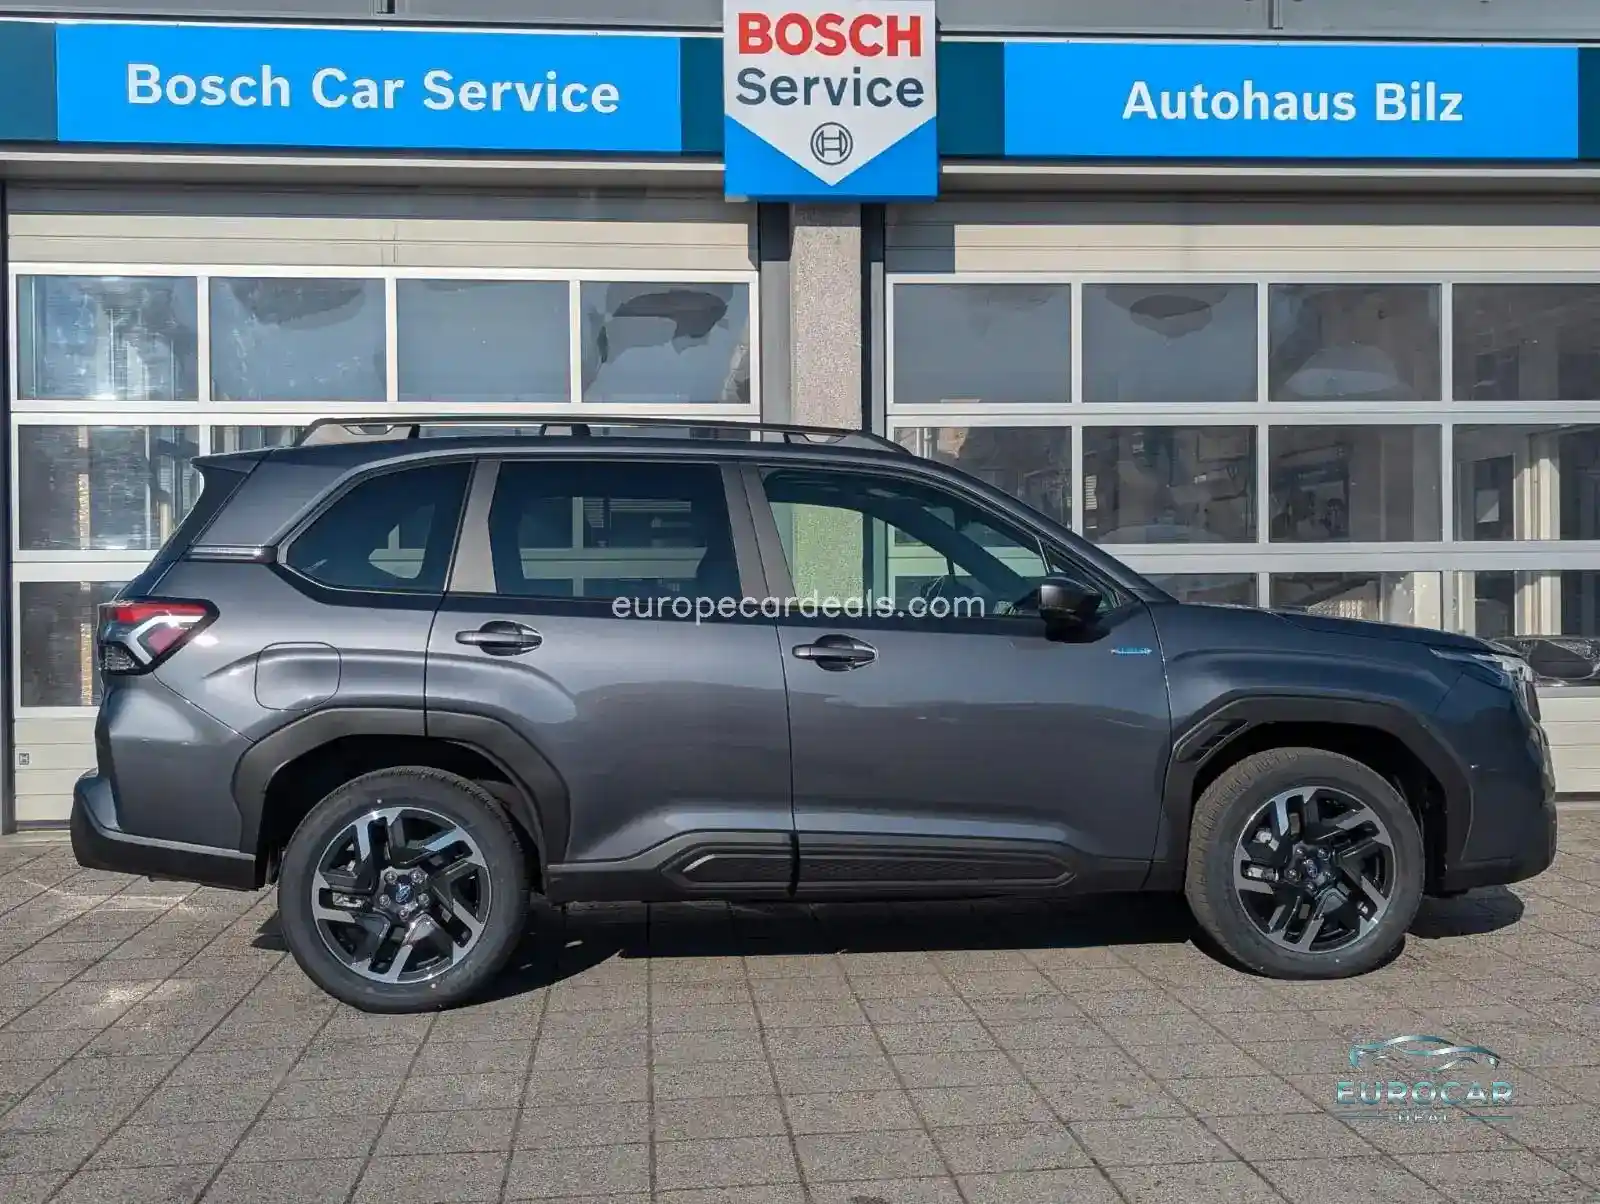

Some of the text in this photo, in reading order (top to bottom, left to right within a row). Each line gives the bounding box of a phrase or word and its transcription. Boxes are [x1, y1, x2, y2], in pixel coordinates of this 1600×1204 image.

[738, 12, 922, 57] BOSCH
[127, 63, 620, 113] Bosch Car Service
[736, 67, 925, 108] Service
[1122, 79, 1463, 121] Autohaus Bilz
